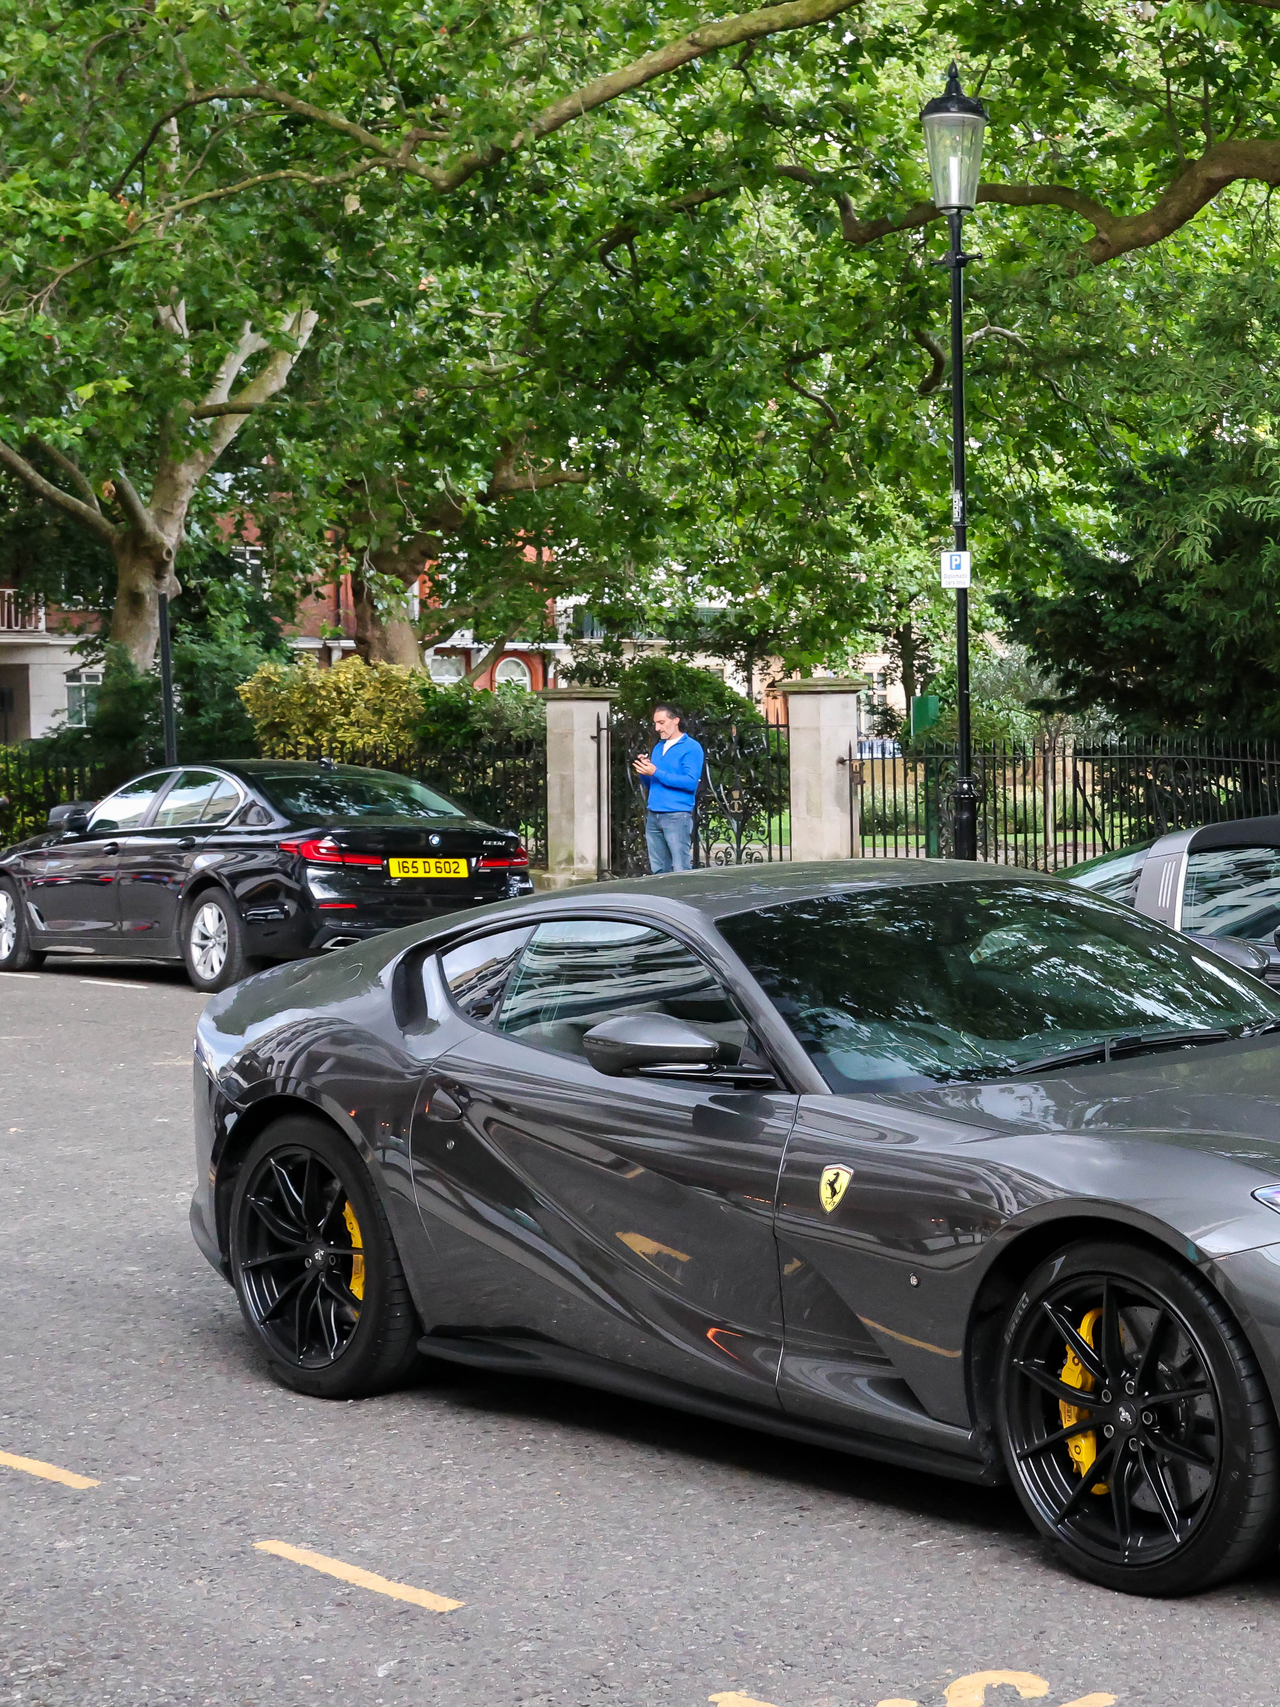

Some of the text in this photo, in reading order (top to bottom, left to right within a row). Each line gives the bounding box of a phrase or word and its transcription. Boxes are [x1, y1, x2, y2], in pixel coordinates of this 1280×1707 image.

[951, 555, 960, 570] P
[397, 860, 460, 874] 165 D 602
